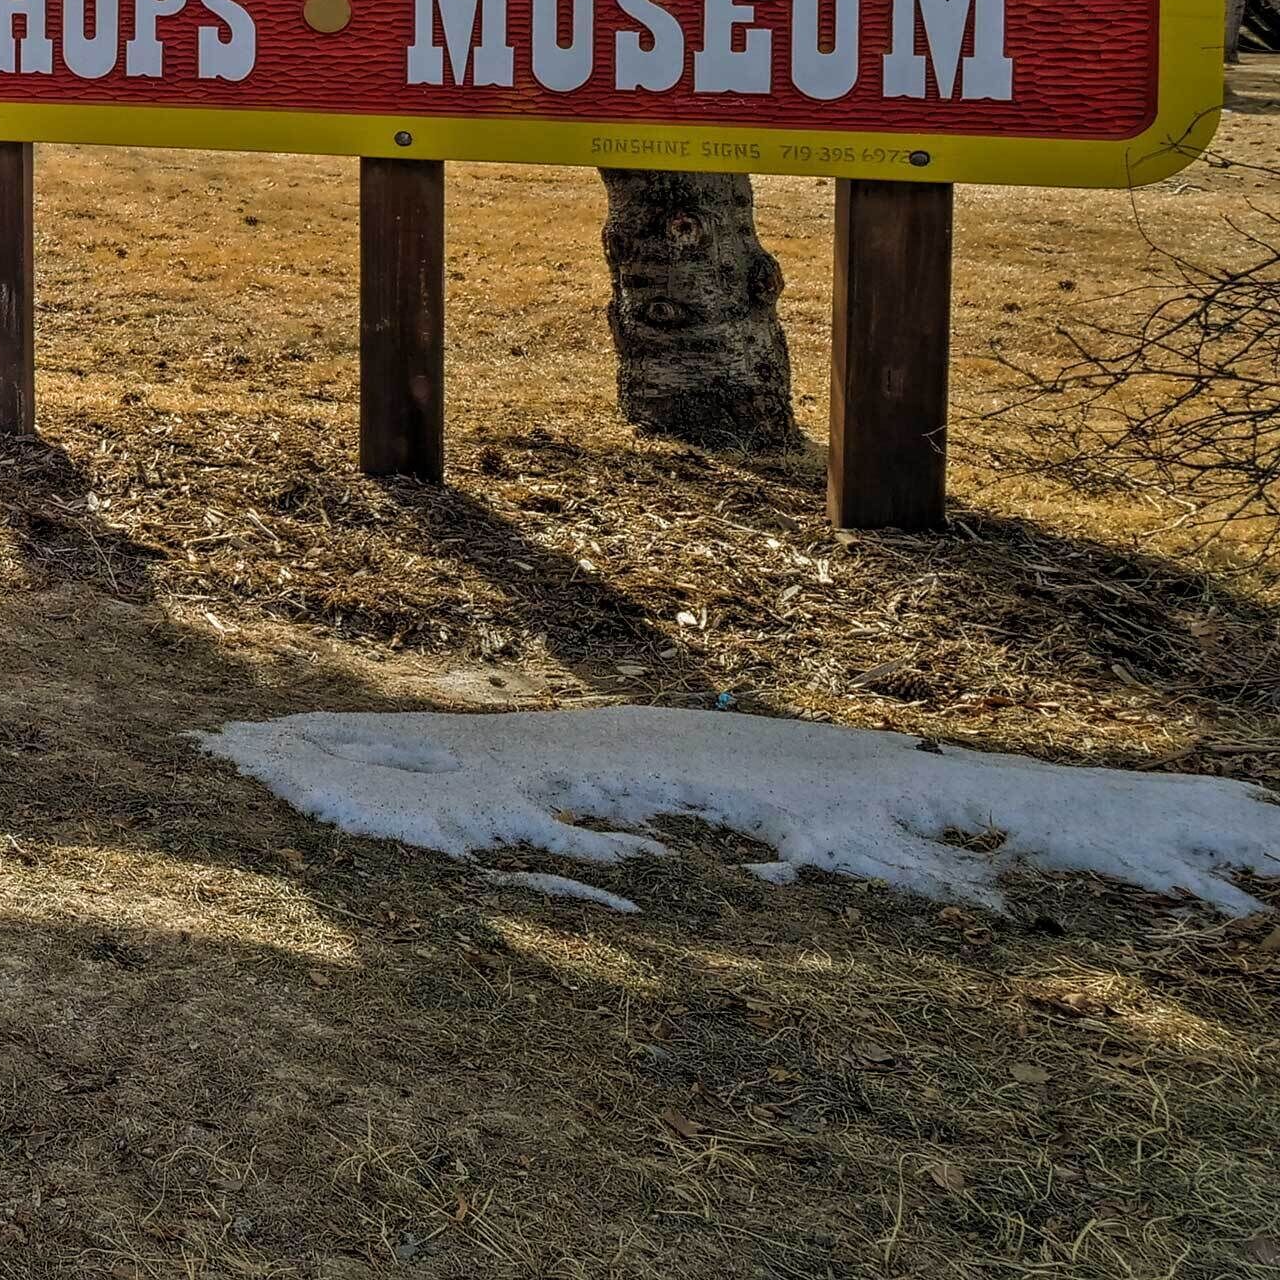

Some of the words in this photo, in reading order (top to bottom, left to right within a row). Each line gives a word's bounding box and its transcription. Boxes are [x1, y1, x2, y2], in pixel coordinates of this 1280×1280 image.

[701, 141, 761, 160] SIGNS
[780, 145, 811, 161] 719
[818, 147, 856, 162] 395
